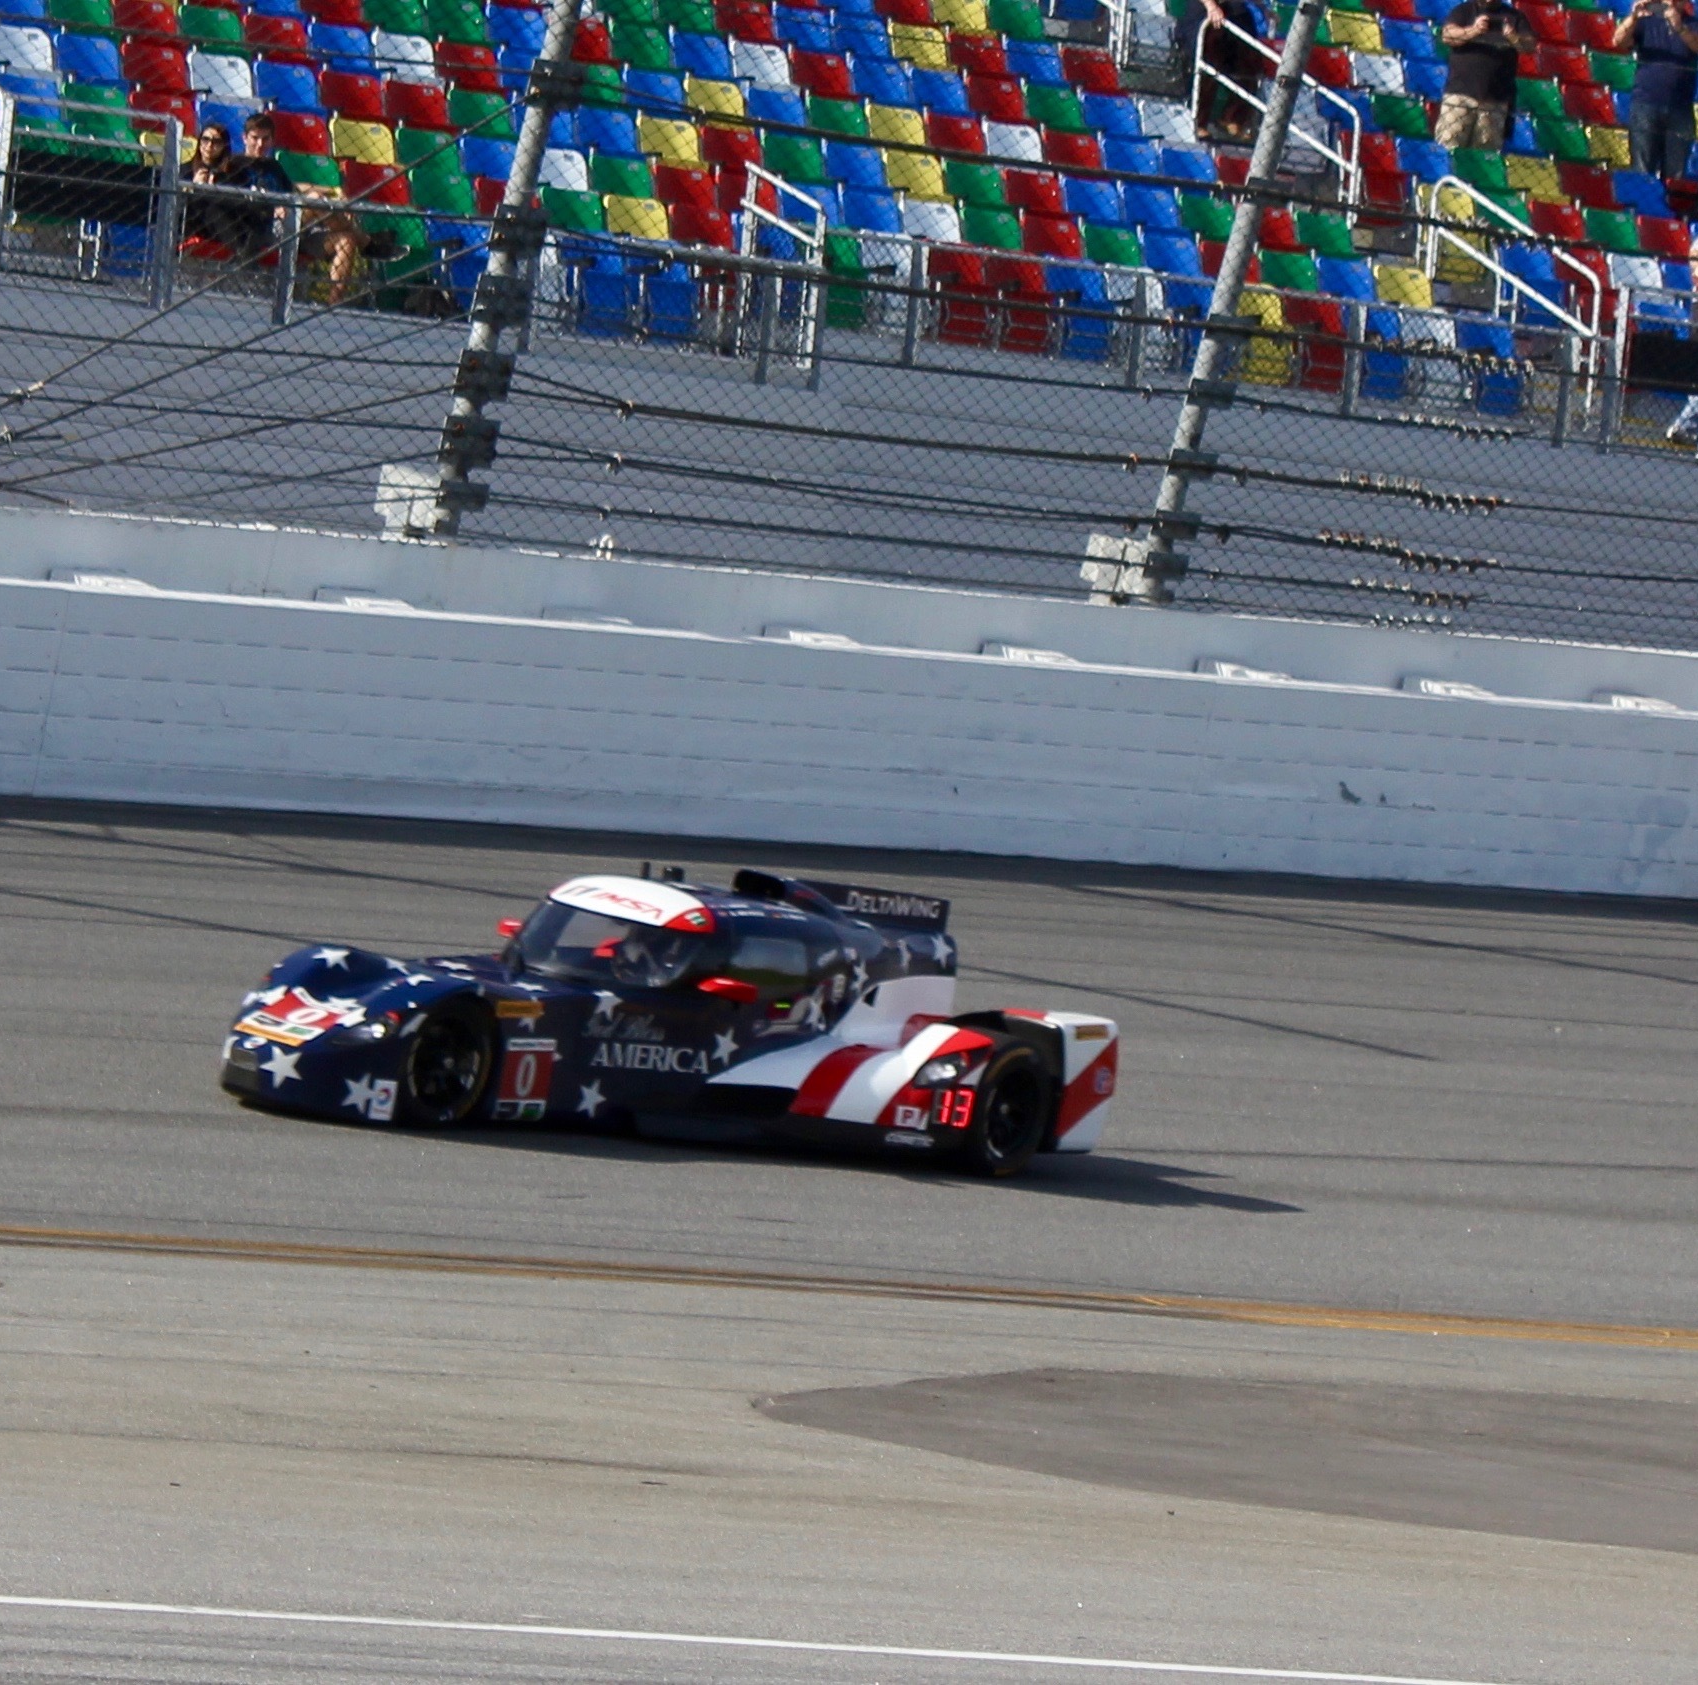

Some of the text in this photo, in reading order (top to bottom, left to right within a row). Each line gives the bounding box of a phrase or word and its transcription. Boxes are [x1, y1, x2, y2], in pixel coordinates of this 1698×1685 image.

[589, 892, 664, 919] IMSA
[845, 890, 941, 919] DELTAWING
[284, 1007, 329, 1025] 0
[589, 1043, 709, 1074] AMERICA
[515, 1053, 537, 1098] 0
[939, 1088, 975, 1128] 13
